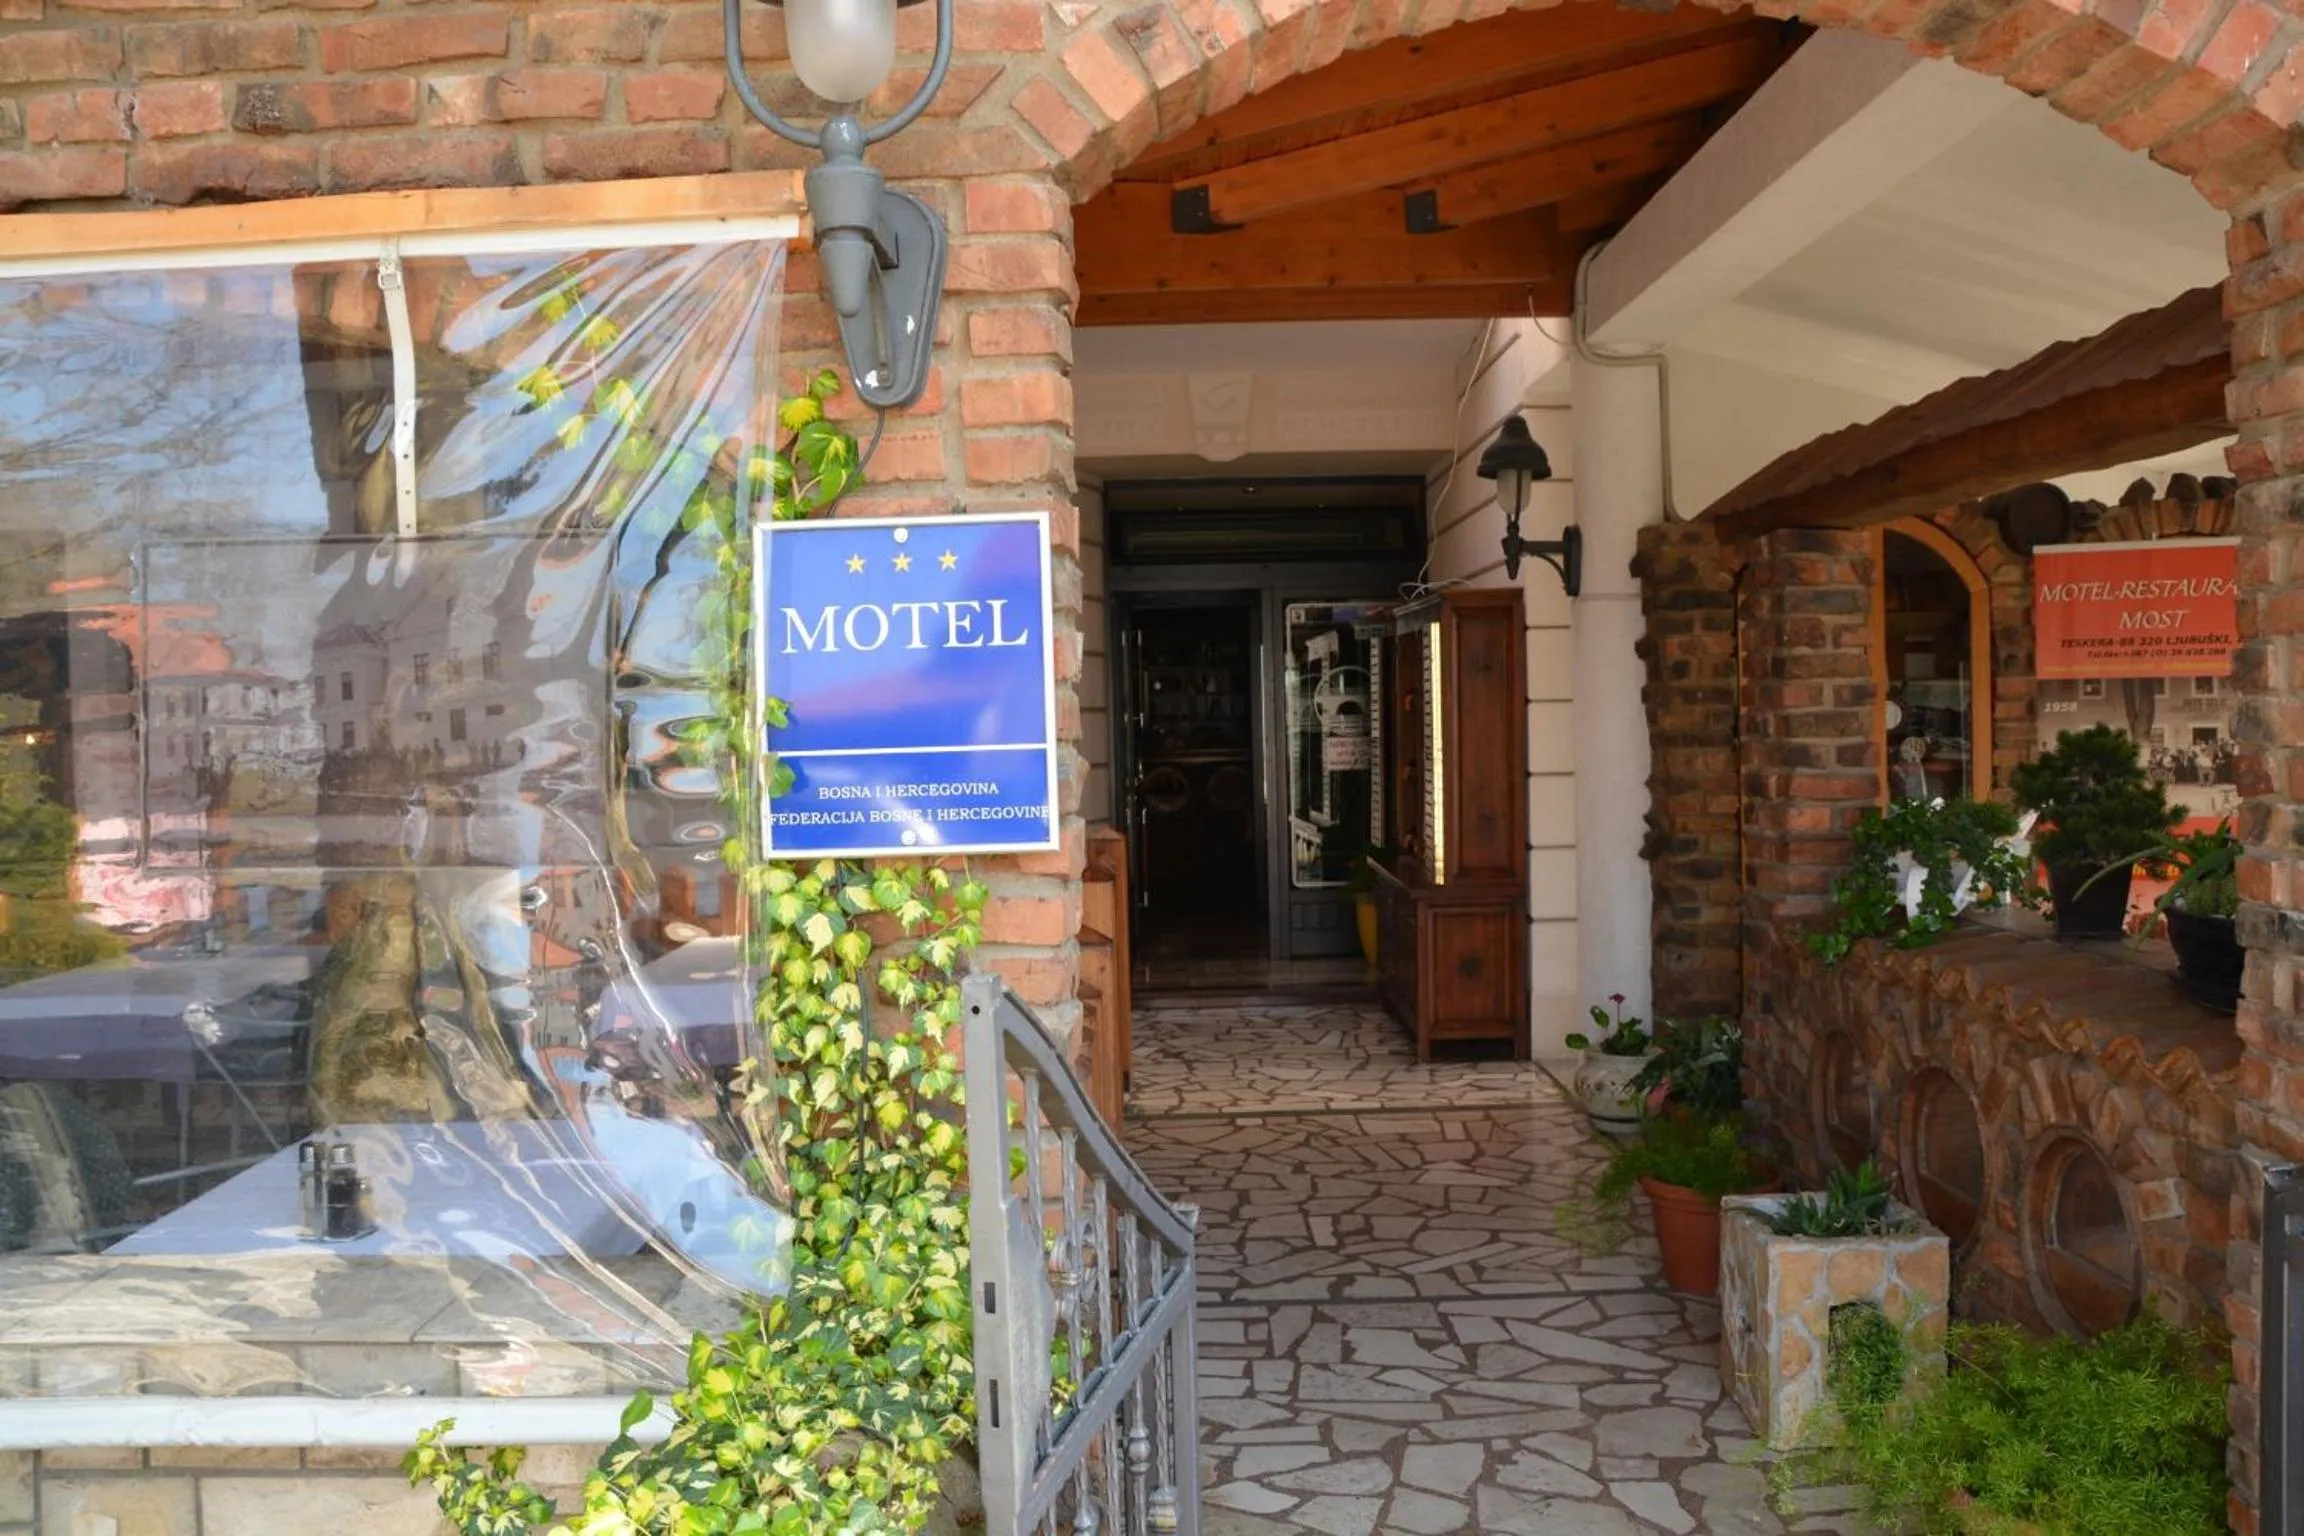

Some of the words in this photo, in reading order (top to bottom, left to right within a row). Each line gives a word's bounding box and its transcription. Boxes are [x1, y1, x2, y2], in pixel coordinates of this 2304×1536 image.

[780, 600, 1029, 653] MOTEL
[2118, 609, 2191, 630] MOST
[2043, 700, 2078, 713] 1958
[818, 786, 871, 800] BOSNA
[874, 786, 882, 798] I
[885, 782, 999, 798] HERCEGOVINA
[769, 812, 865, 826] FEDERACIJA
[869, 808, 922, 823] BOSNE
[927, 808, 933, 821] I
[937, 804, 1050, 821] HERCEGOVINE
